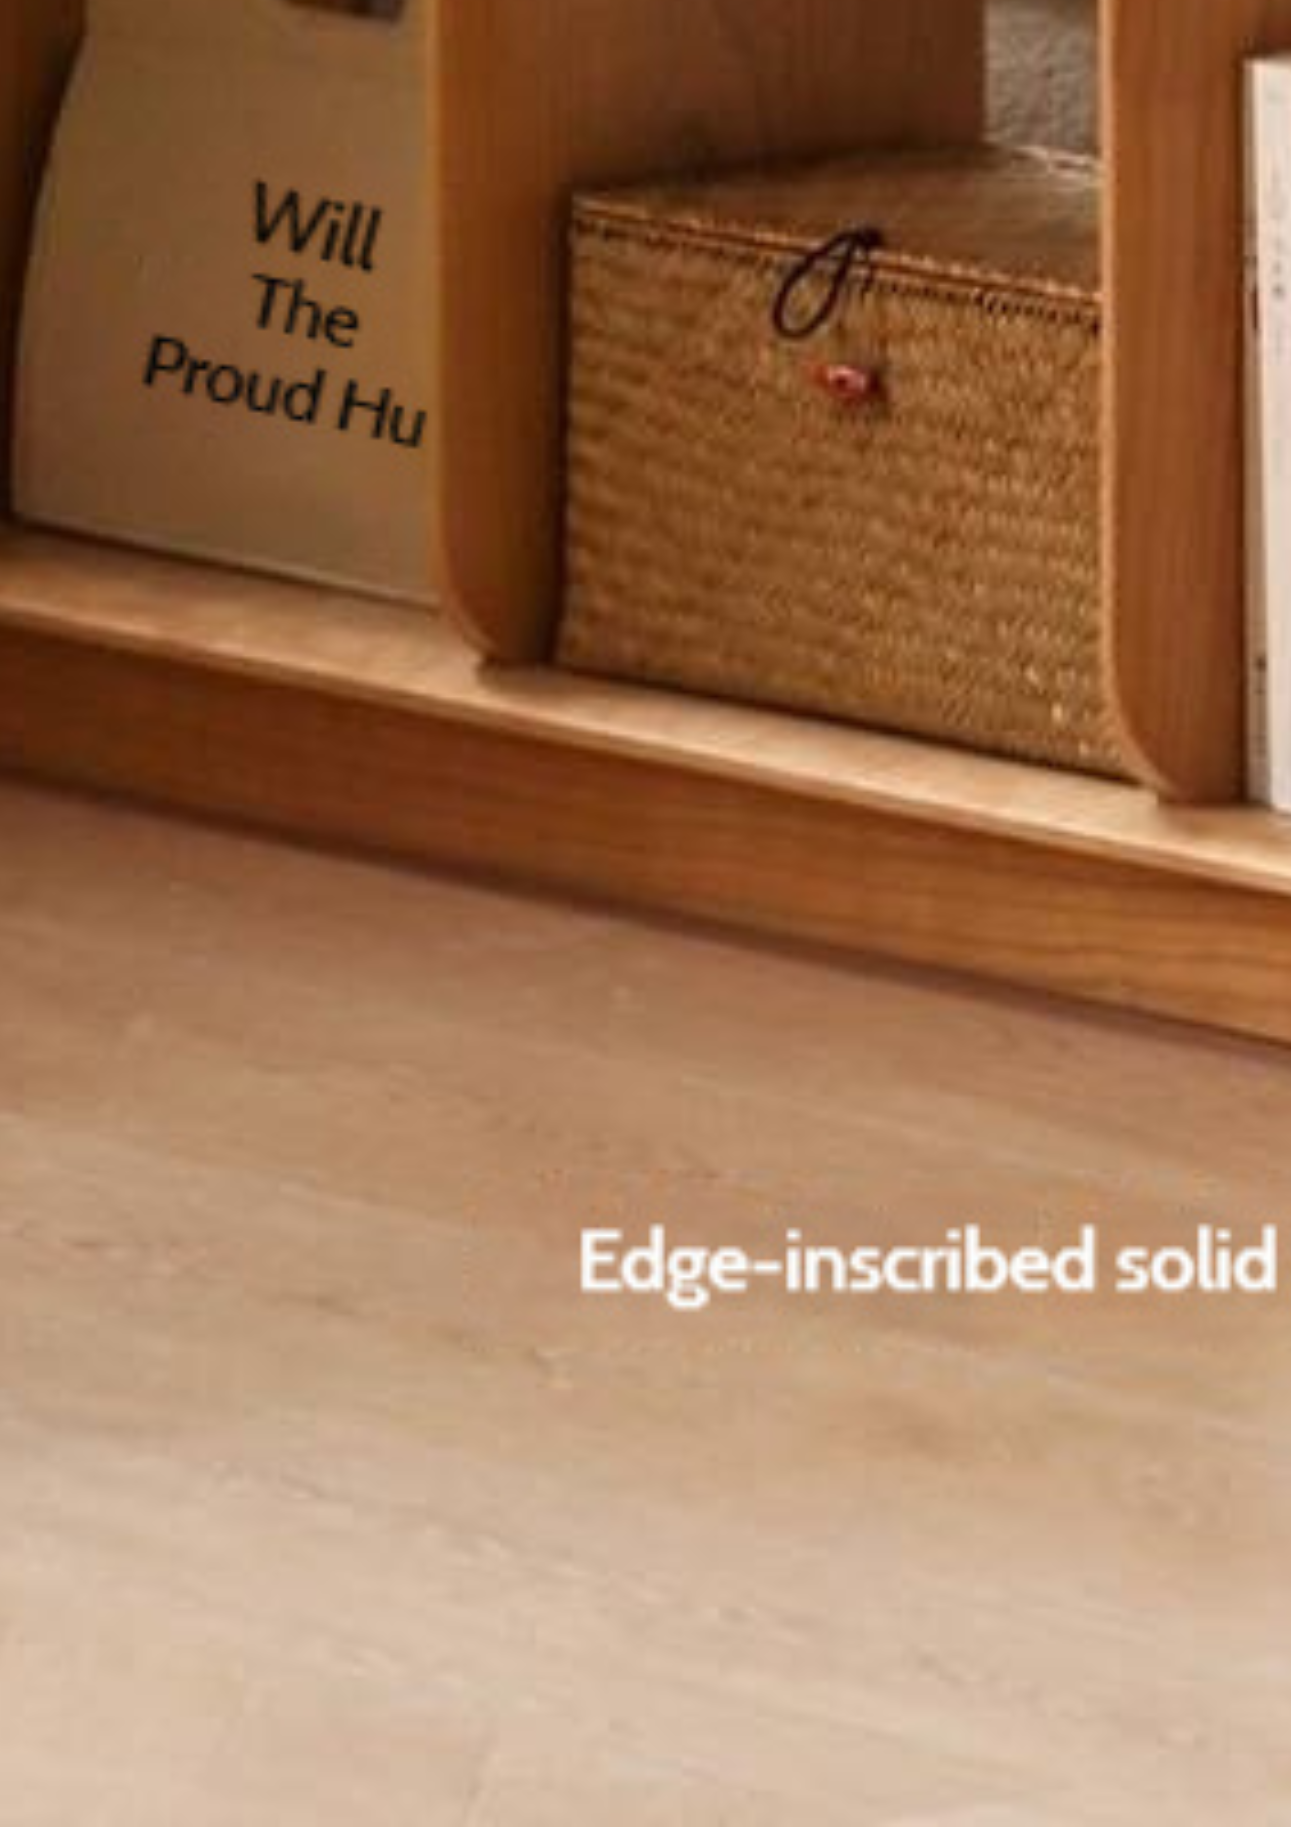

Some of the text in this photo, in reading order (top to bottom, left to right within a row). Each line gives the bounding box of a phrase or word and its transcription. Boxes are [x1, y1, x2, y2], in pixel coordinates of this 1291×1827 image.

[252, 179, 384, 272] Will
[251, 272, 359, 348] The
[142, 330, 427, 448] Proud Hu
